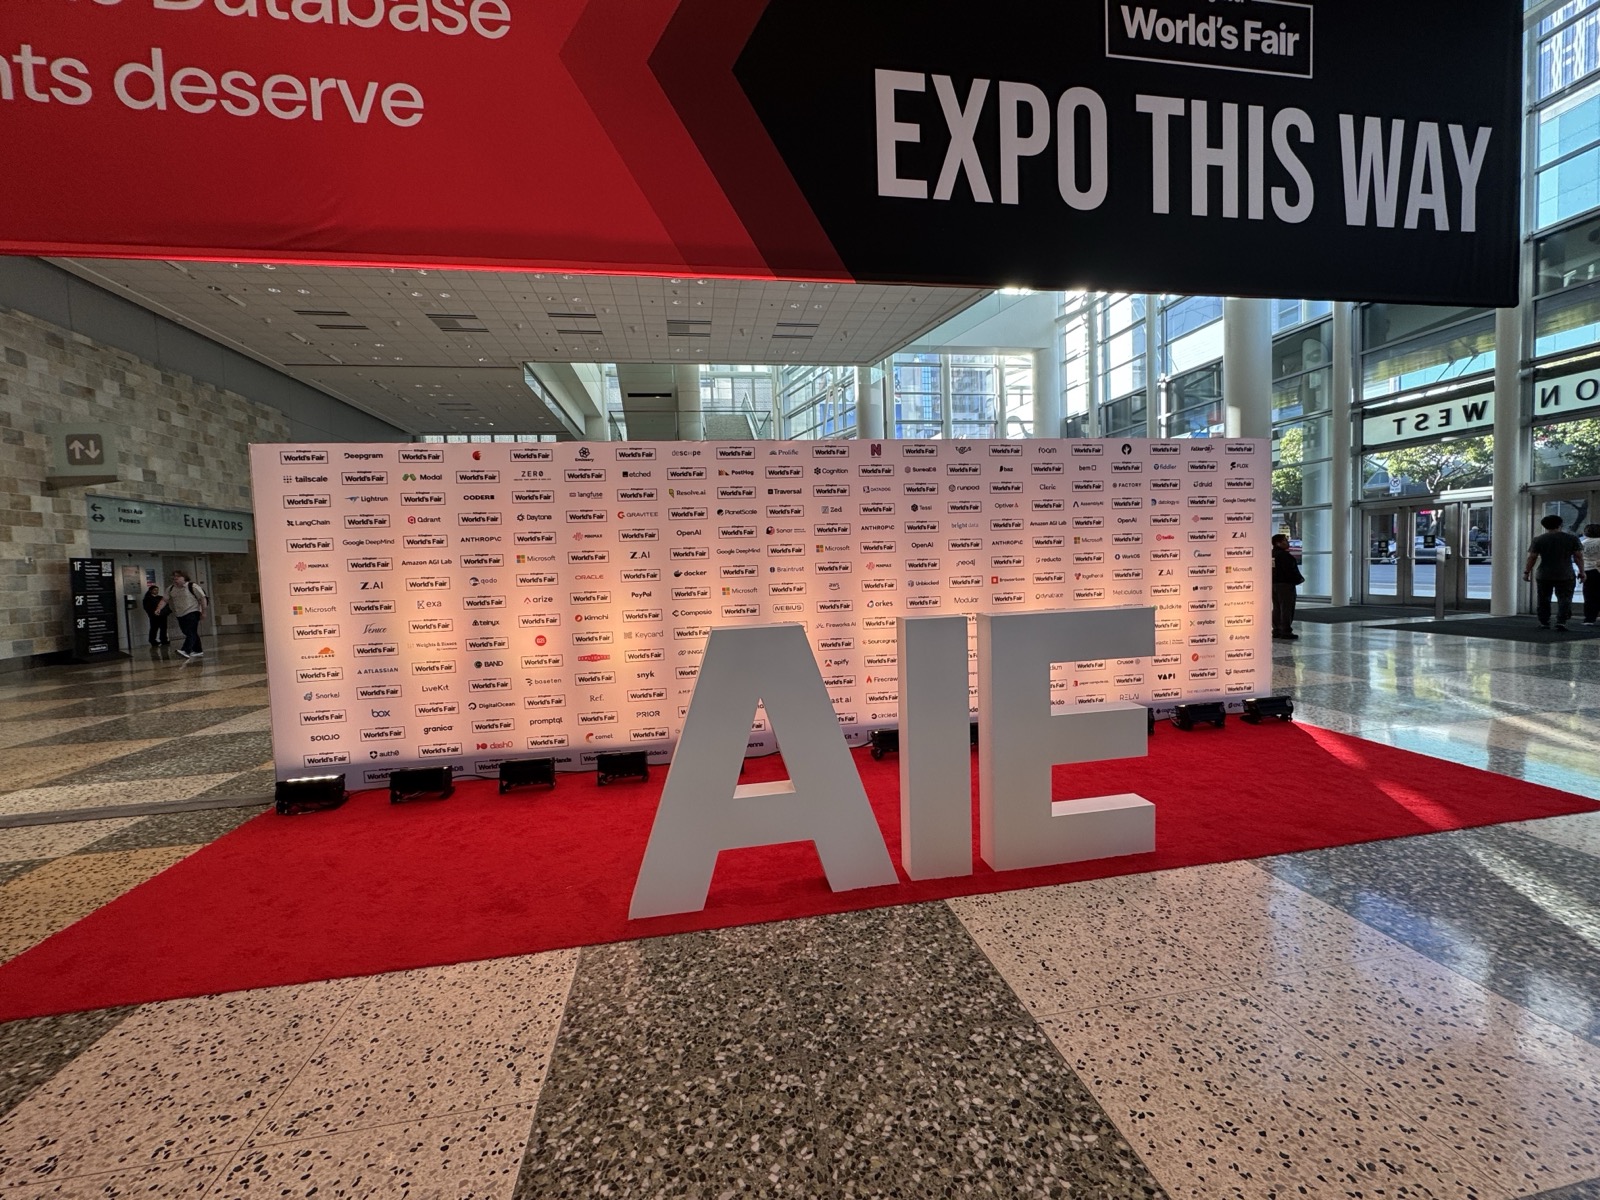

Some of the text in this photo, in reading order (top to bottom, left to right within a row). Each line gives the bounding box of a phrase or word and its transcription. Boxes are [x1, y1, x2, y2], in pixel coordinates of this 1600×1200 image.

[1120, 5, 1299, 56] World's Fair
[113, 47, 424, 127] deserve
[874, 68, 1492, 232] EXPO THIS WAY
[295, 475, 328, 483] tailscale
[577, 491, 603, 499] langfuse
[676, 489, 706, 497] Resolve.ai
[360, 495, 388, 503] Lightrun
[526, 514, 552, 522] Daytona
[184, 514, 243, 531] ELEVATORS
[676, 529, 701, 537] OpenAI
[342, 539, 364, 547] Google
[527, 554, 556, 562] Microsoft
[74, 562, 81, 571] 1F
[75, 596, 84, 605] 2F
[426, 600, 442, 608] exa
[954, 596, 979, 604] Modular
[305, 606, 337, 614] Microsoft
[680, 608, 712, 616] Composio
[77, 619, 85, 628] 3F
[635, 631, 664, 639] Keycard
[637, 670, 655, 679] snyk
[479, 701, 515, 709] DigitalOcean
[371, 709, 391, 717] box
[423, 725, 453, 735] granica
[307, 755, 347, 763] World's Fair
